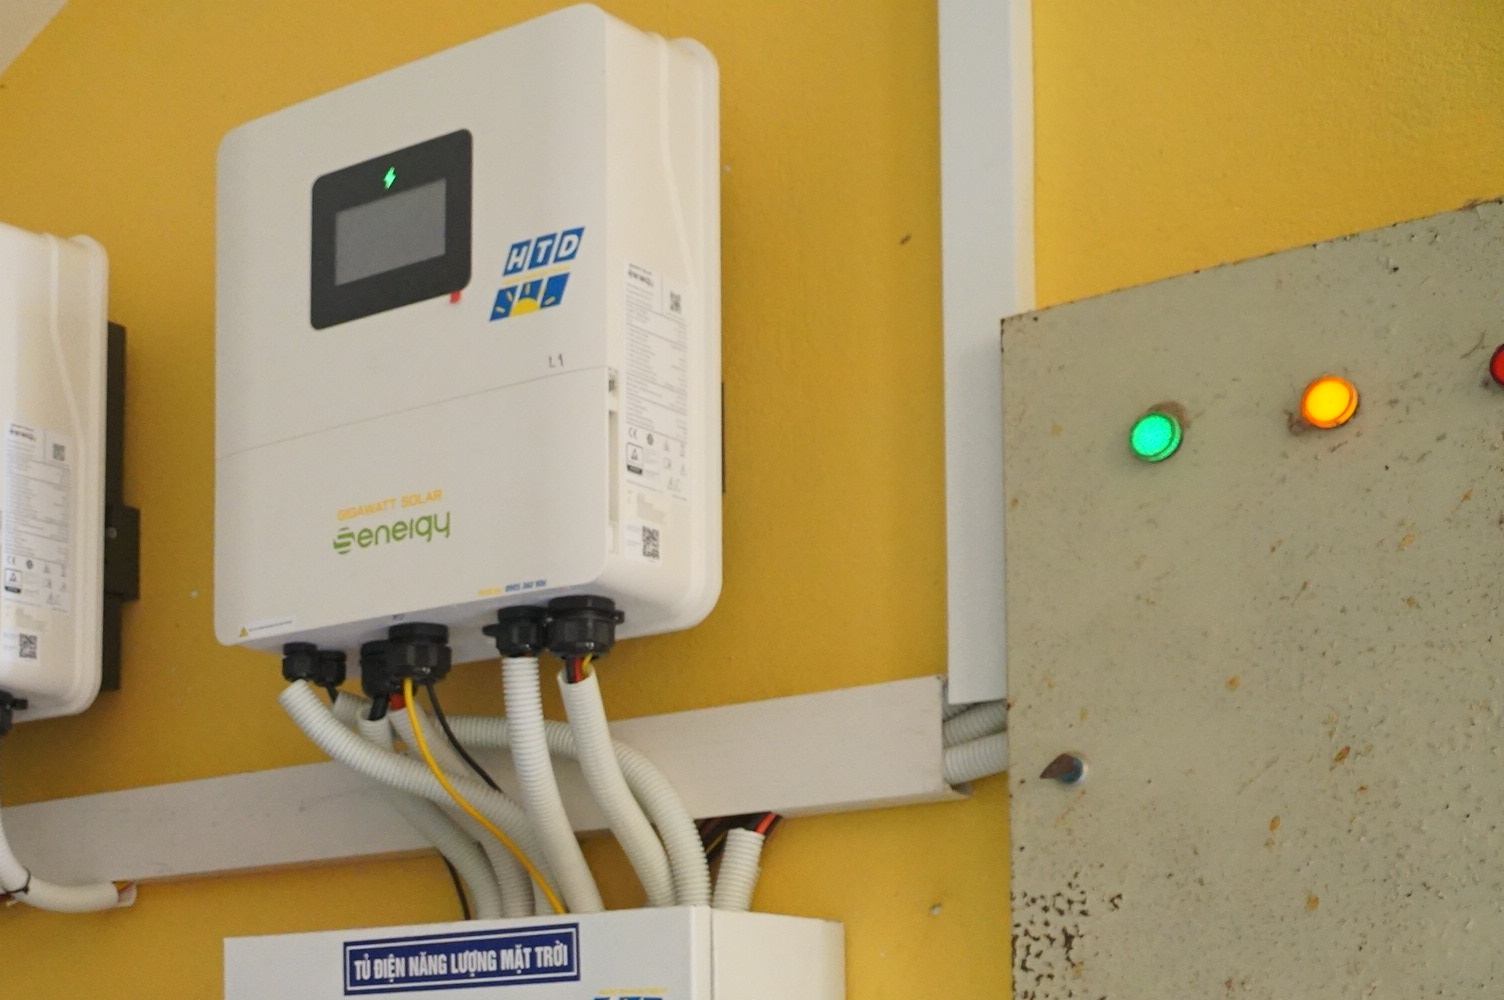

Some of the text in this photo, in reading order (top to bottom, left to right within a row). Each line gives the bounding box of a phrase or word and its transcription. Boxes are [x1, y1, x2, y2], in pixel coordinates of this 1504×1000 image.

[505, 230, 582, 273] HTD
[401, 489, 443, 507] SOLAR
[354, 940, 569, 983] TỦ ĐIỆN NĂNG LƯỢNG MẶT TRỜI
